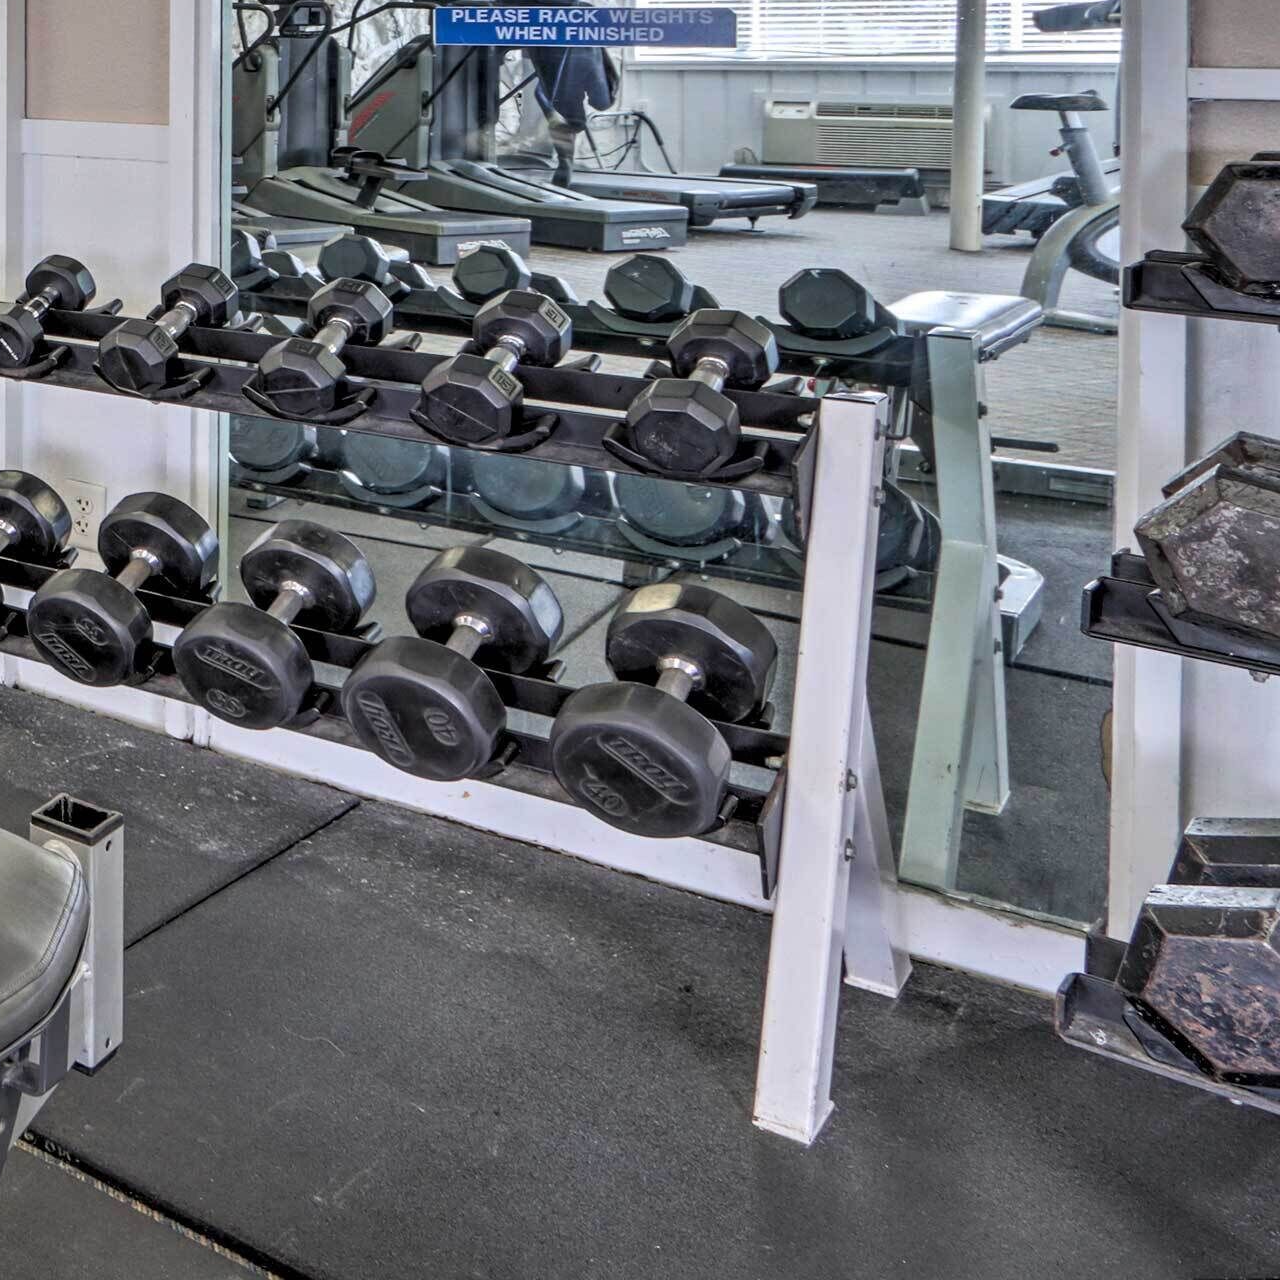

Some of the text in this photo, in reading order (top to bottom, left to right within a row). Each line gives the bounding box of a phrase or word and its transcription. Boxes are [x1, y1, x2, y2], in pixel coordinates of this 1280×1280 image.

[451, 9, 713, 24] PLEASE RACK WEIGHTS
[495, 27, 665, 41] WHEN FINISHED
[610, 736, 689, 793] TROY
[588, 782, 624, 810] 40
